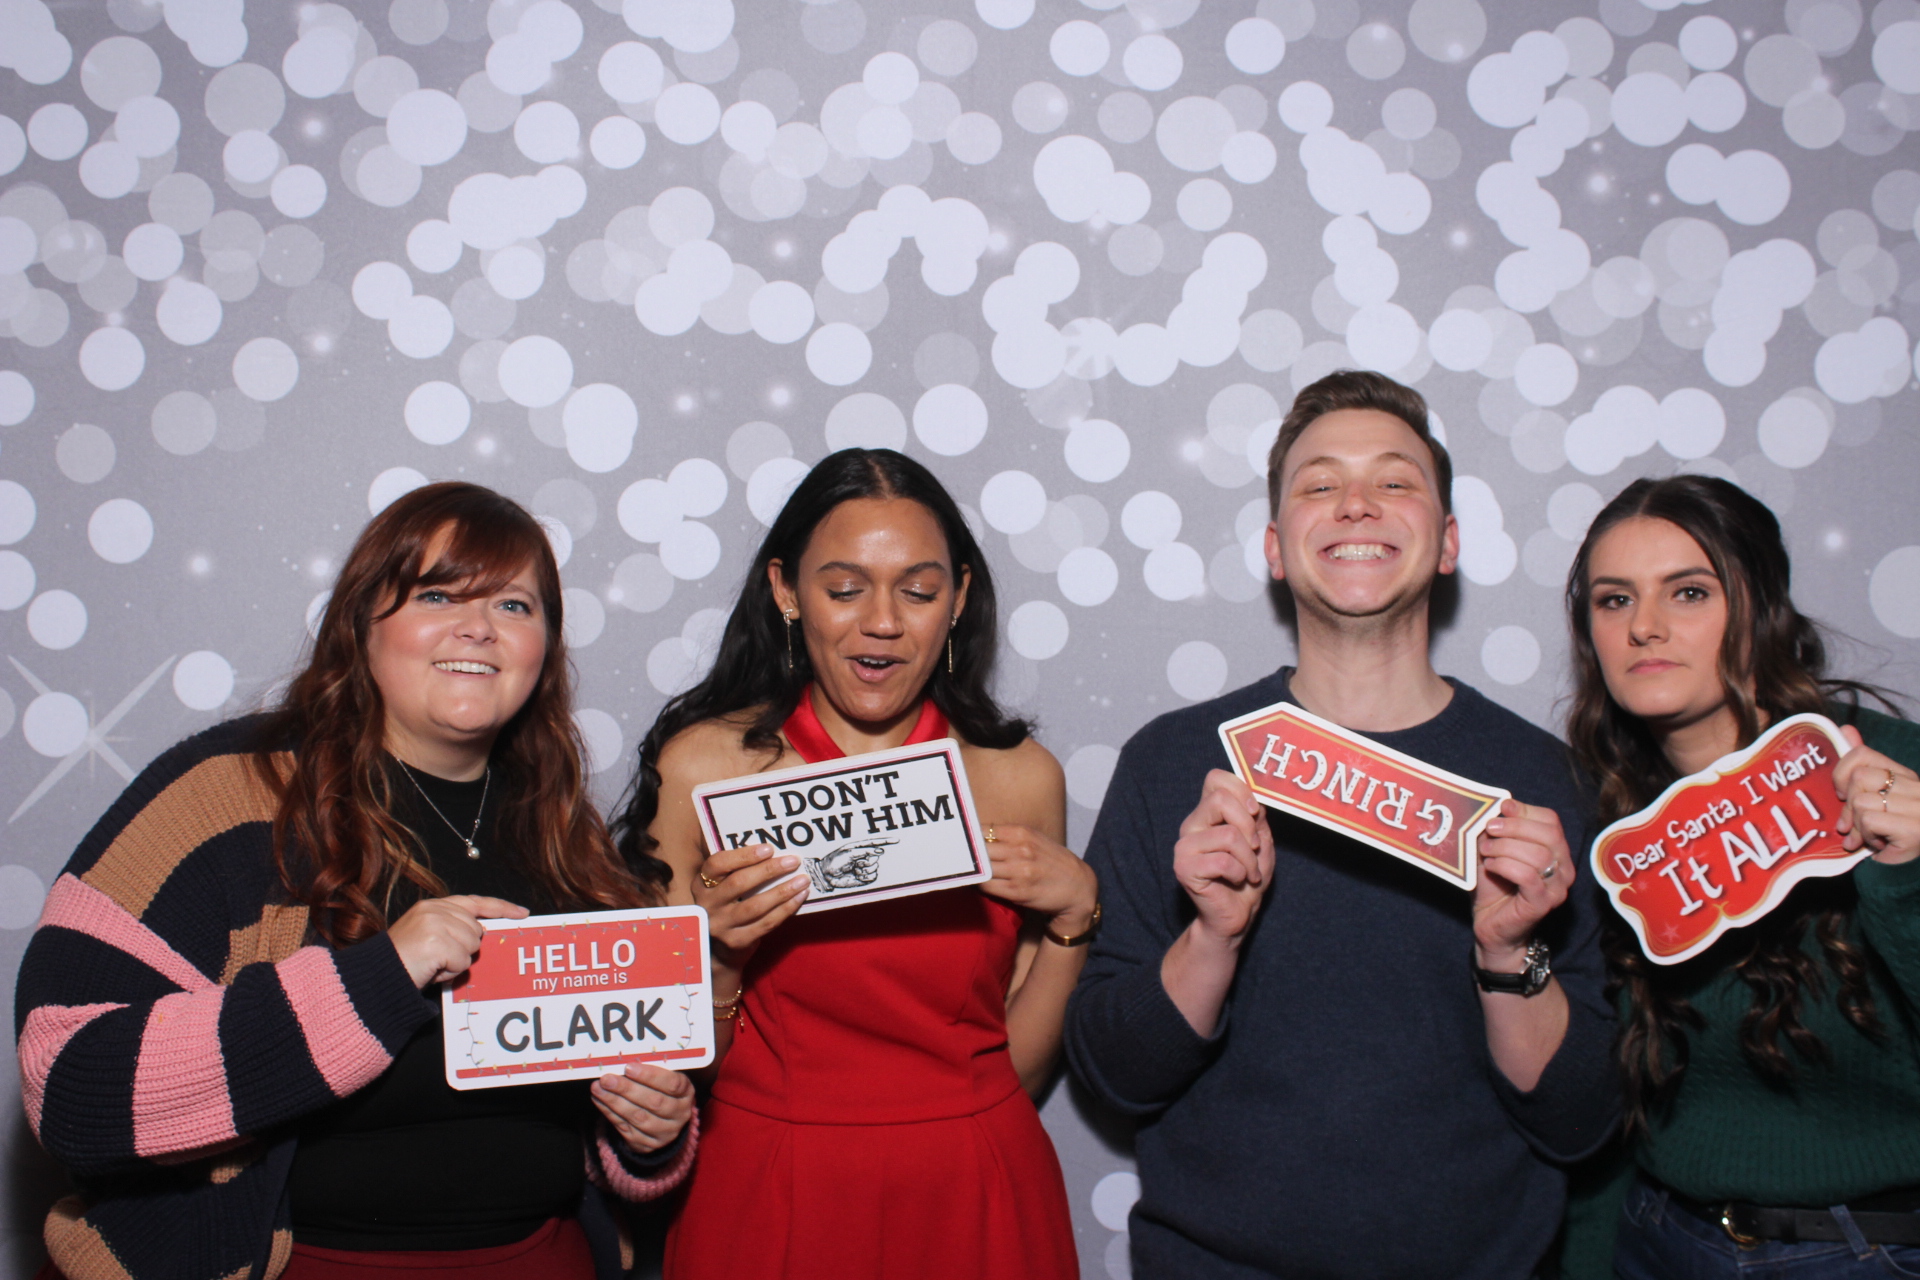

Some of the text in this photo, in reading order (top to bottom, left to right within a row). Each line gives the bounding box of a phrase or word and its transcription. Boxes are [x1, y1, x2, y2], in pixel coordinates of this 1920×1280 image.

[759, 771, 899, 820] I DON'T
[1253, 733, 1454, 846] GRINCH
[726, 794, 954, 850] KNOW HIM
[1614, 839, 1665, 878] Dear
[1666, 798, 1743, 848] Santa,
[1740, 775, 1763, 805] I
[1659, 789, 1826, 916] It ALL!
[518, 939, 636, 975] HELLO
[533, 969, 628, 992] my name is
[496, 998, 667, 1052] CLARK
